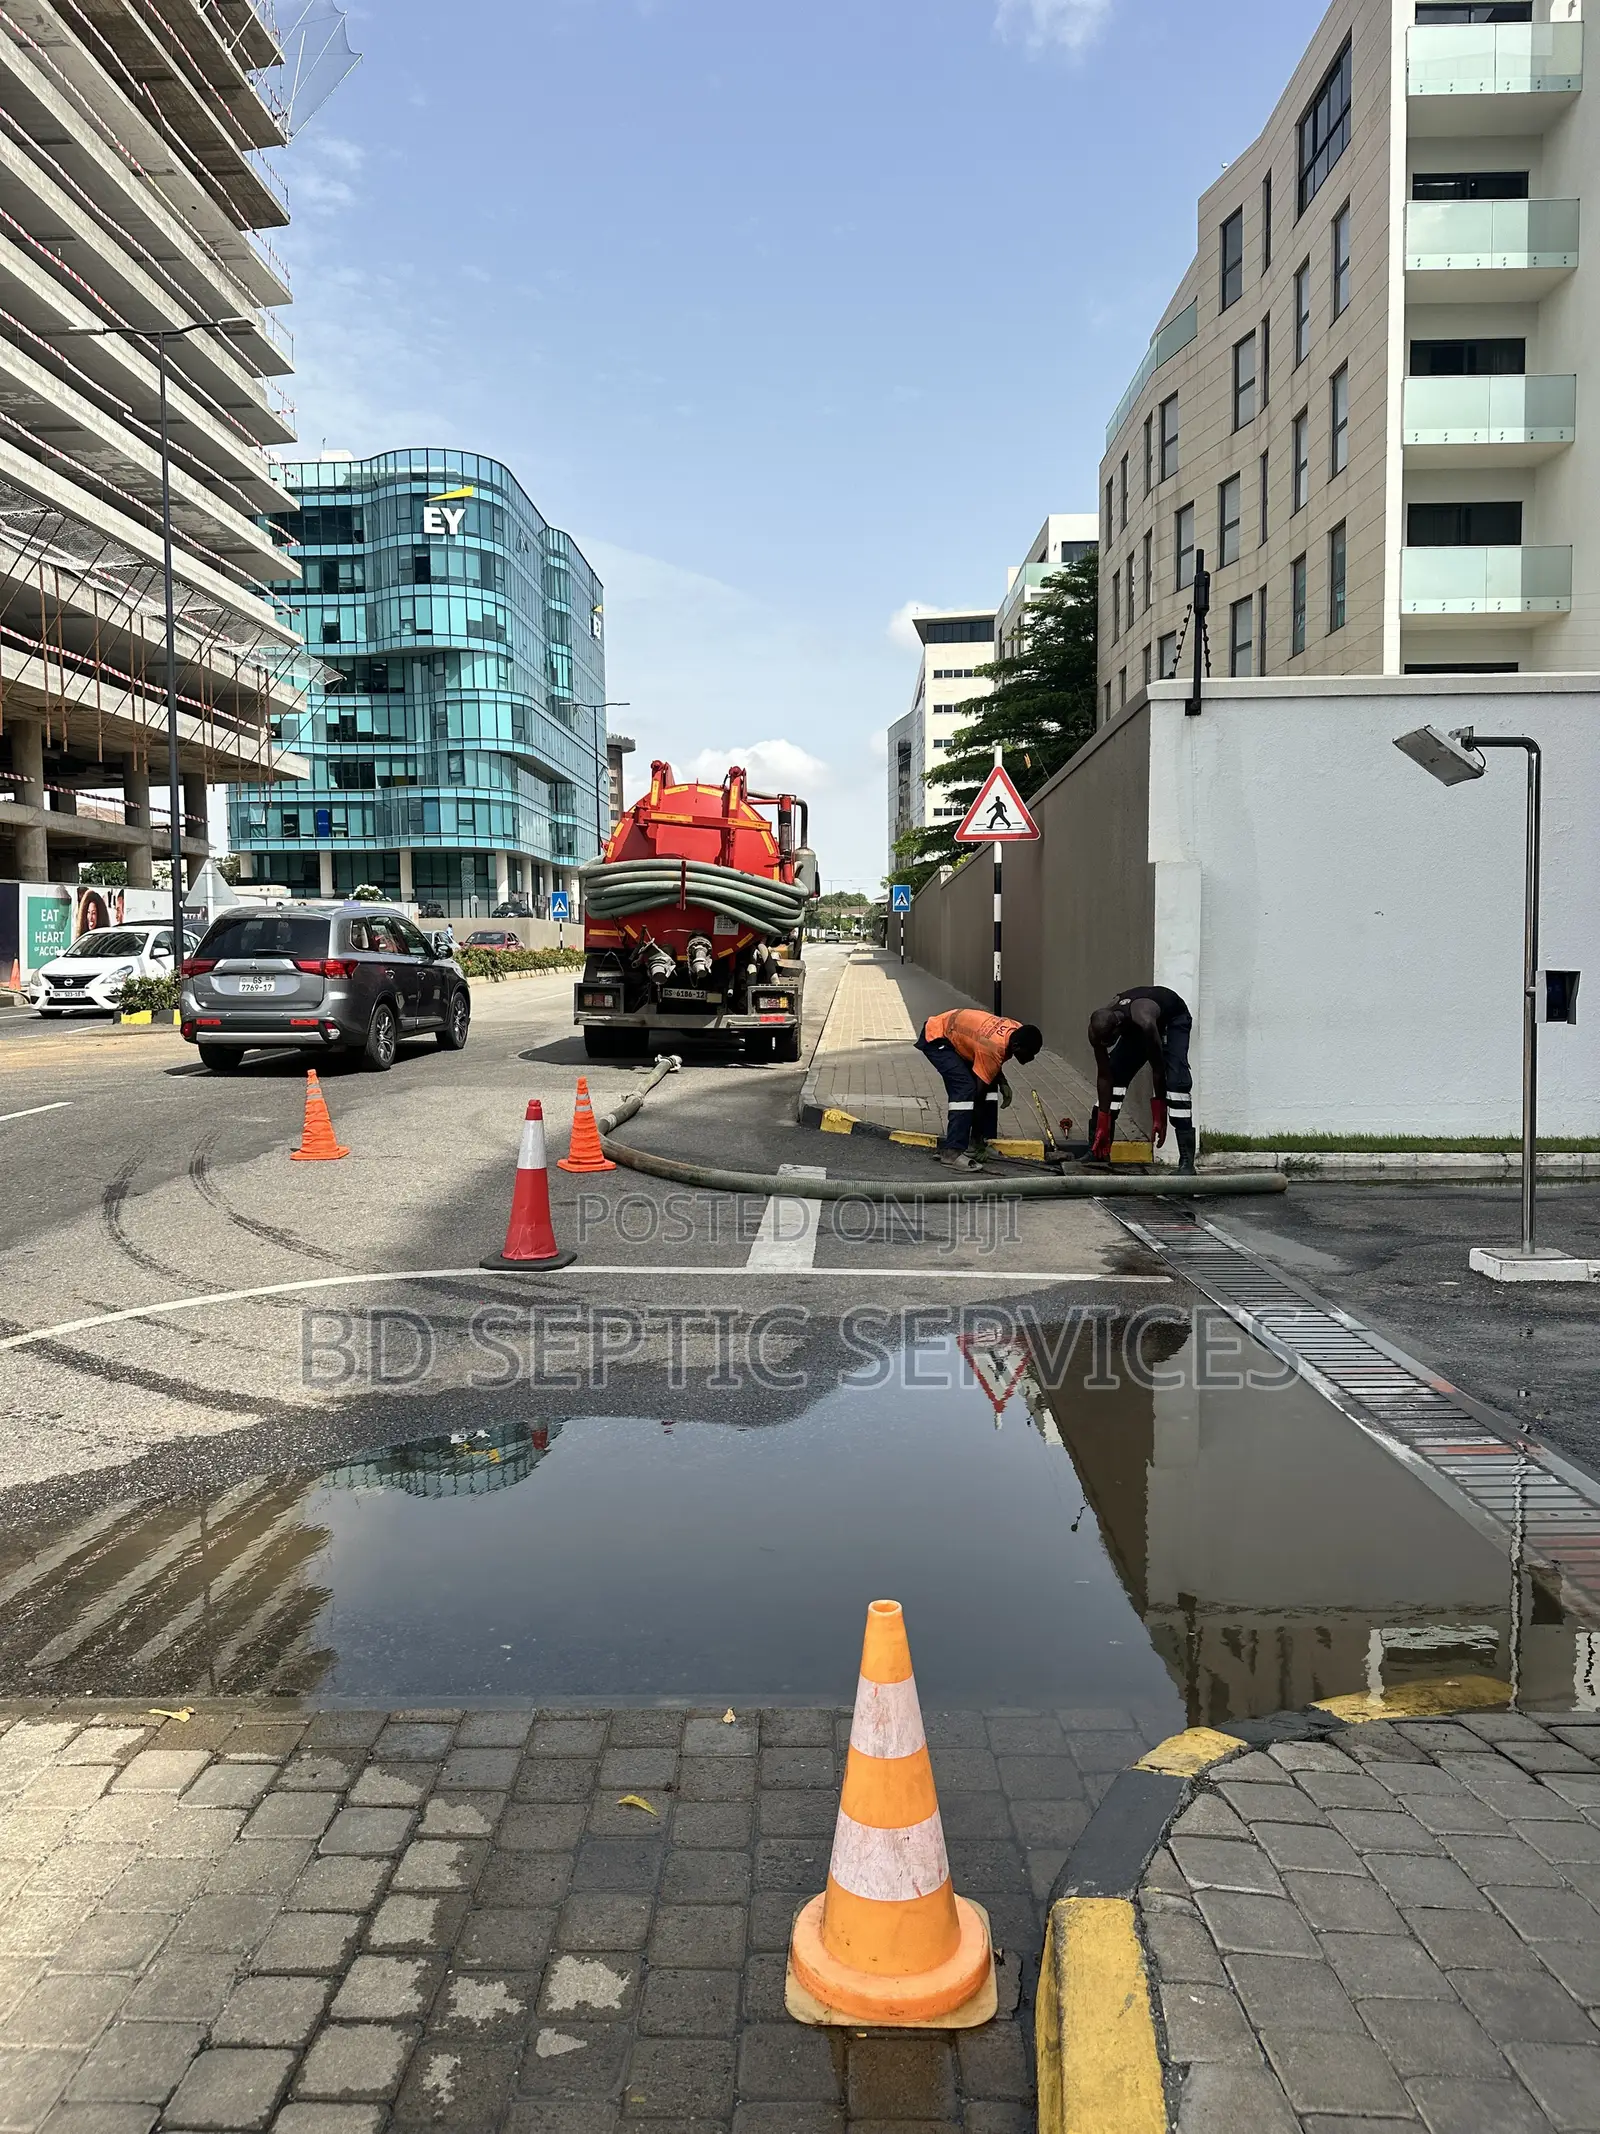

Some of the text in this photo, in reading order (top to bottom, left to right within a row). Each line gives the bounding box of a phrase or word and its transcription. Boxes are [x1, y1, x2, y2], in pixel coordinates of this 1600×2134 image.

[424, 507, 466, 535] EY
[41, 909, 59, 921] EAT
[35, 931, 64, 943] HEART
[253, 976, 263, 984] GS
[676, 990, 705, 999] 6186-12
